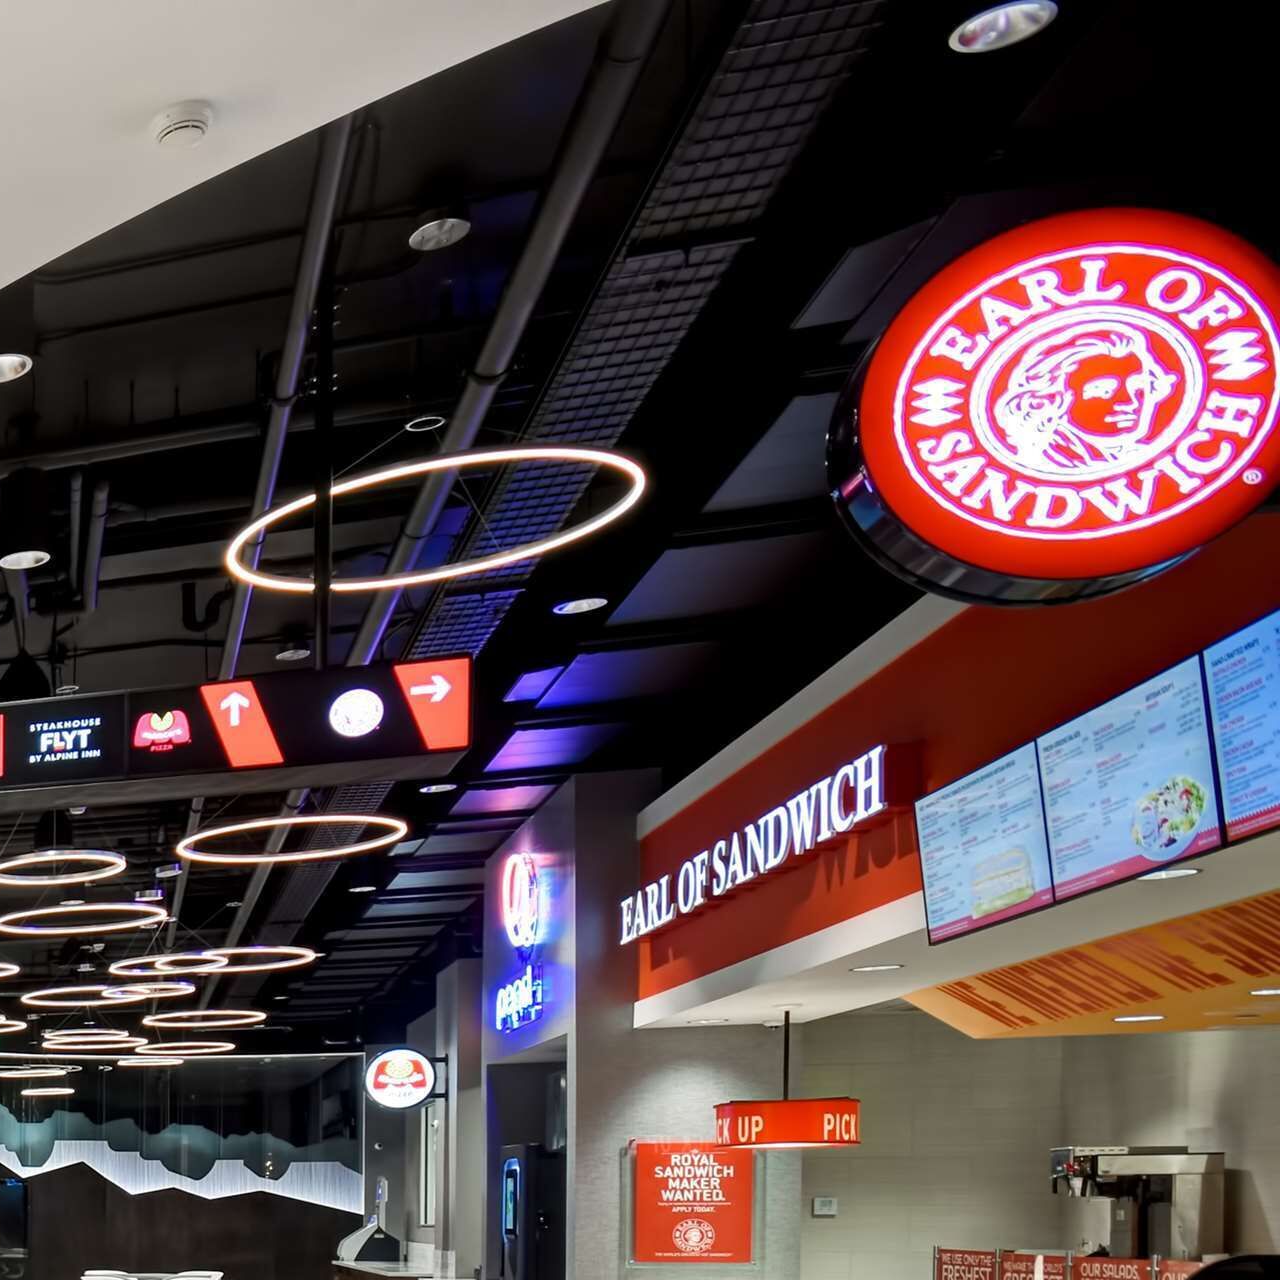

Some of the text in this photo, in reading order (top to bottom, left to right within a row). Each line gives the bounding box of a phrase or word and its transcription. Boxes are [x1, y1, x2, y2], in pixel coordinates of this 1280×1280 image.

[929, 258, 1246, 371] EARL OF
[916, 389, 1262, 528] SANDWICH
[29, 717, 101, 733] STEAKHOUSE
[40, 729, 92, 753] FLYT
[29, 749, 101, 764] BY ALPINE INN
[620, 874, 676, 945] EARL
[677, 851, 709, 914] OF
[712, 744, 888, 896] SANDWICH
[737, 1115, 764, 1143] UP
[823, 1113, 857, 1141] PICK
[671, 1154, 718, 1166] ROYAL
[654, 1166, 734, 1178] SANDWICH
[668, 1178, 720, 1190] MAKER
[661, 1189, 726, 1201] WANTED.
[942, 1253, 992, 1266] WE USE ONLY THE
[1080, 1263, 1101, 1278] OUR
